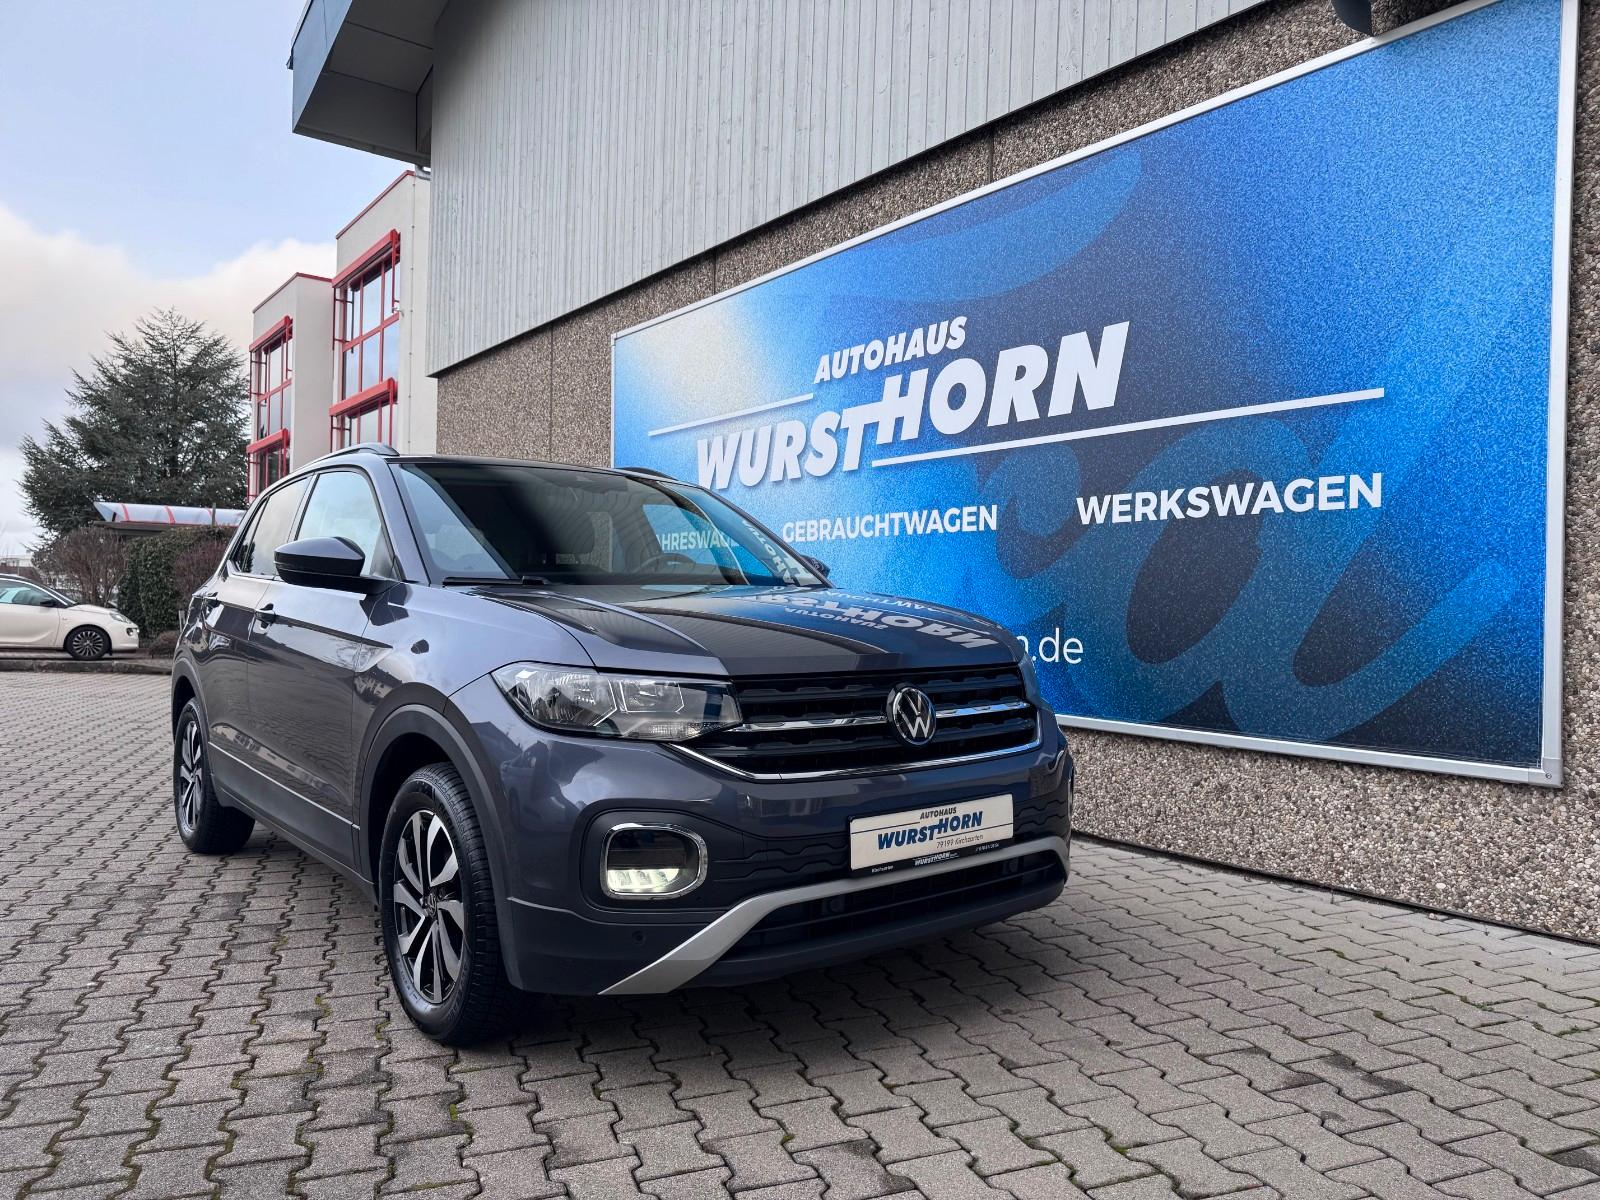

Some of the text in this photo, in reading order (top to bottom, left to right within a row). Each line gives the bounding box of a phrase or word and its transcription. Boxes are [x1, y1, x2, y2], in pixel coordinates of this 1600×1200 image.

[814, 316, 967, 384] AUTOHAUS
[696, 321, 1130, 491] WURSTHORN
[782, 505, 998, 543] GEBRAUCHTWAGEN
[1076, 472, 1382, 525] WERKSWAGEN
[878, 811, 983, 850] WURSTHORN
[920, 806, 957, 820] AUTOHAUS
